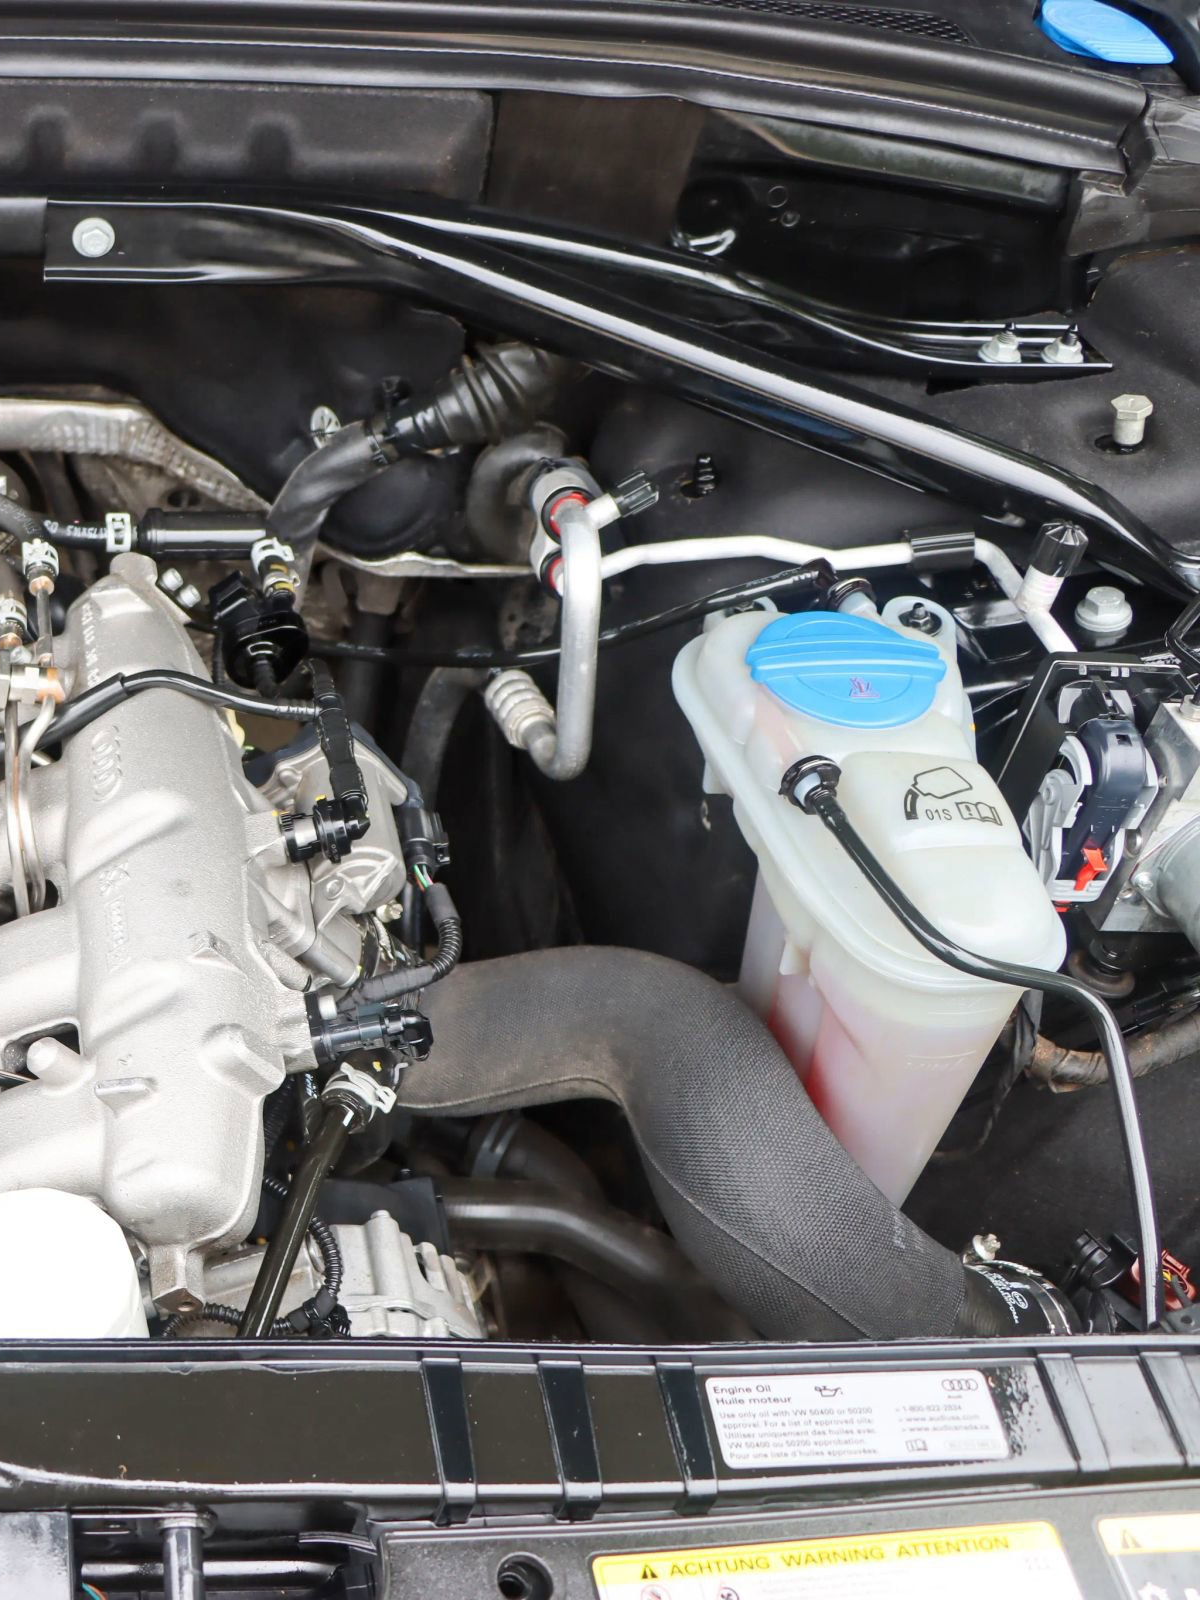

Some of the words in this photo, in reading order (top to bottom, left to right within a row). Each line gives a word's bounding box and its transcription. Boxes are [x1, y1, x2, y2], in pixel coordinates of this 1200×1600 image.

[713, 1386, 752, 1395] Engine
[756, 1385, 771, 1393] Oil
[716, 1397, 745, 1405] Huile
[749, 1396, 791, 1404] moteur
[738, 1410, 759, 1419] only
[772, 1408, 789, 1416] with
[791, 1408, 806, 1416] VW
[764, 1420, 778, 1428] For
[803, 1418, 811, 1426] of
[814, 1418, 856, 1427] approved
[670, 1557, 770, 1577] ACHTUNG
[780, 1546, 885, 1567] WARNING
[896, 1536, 1009, 1557] ATTENTION
